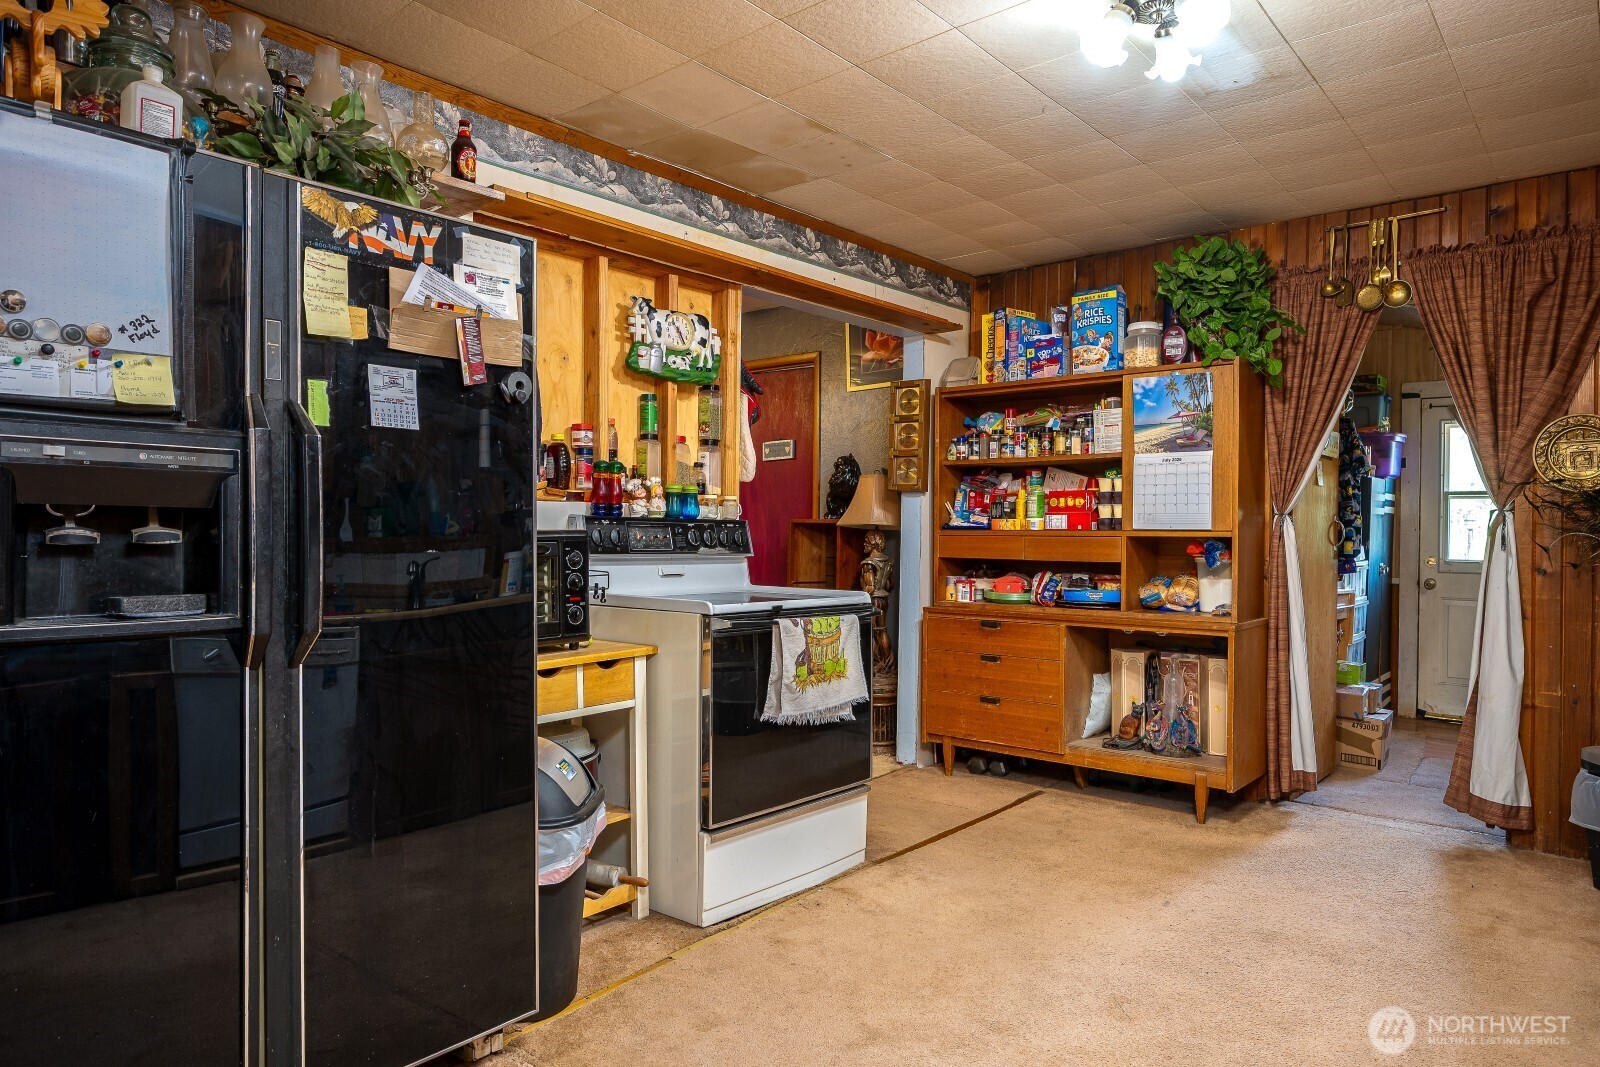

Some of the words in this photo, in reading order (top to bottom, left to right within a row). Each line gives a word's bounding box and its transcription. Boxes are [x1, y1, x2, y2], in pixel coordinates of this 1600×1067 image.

[1077, 294, 1096, 302] FAMILY
[1084, 307, 1104, 319] RICE
[1076, 315, 1112, 330] KRISPIES
[128, 324, 160, 343] Floyd
